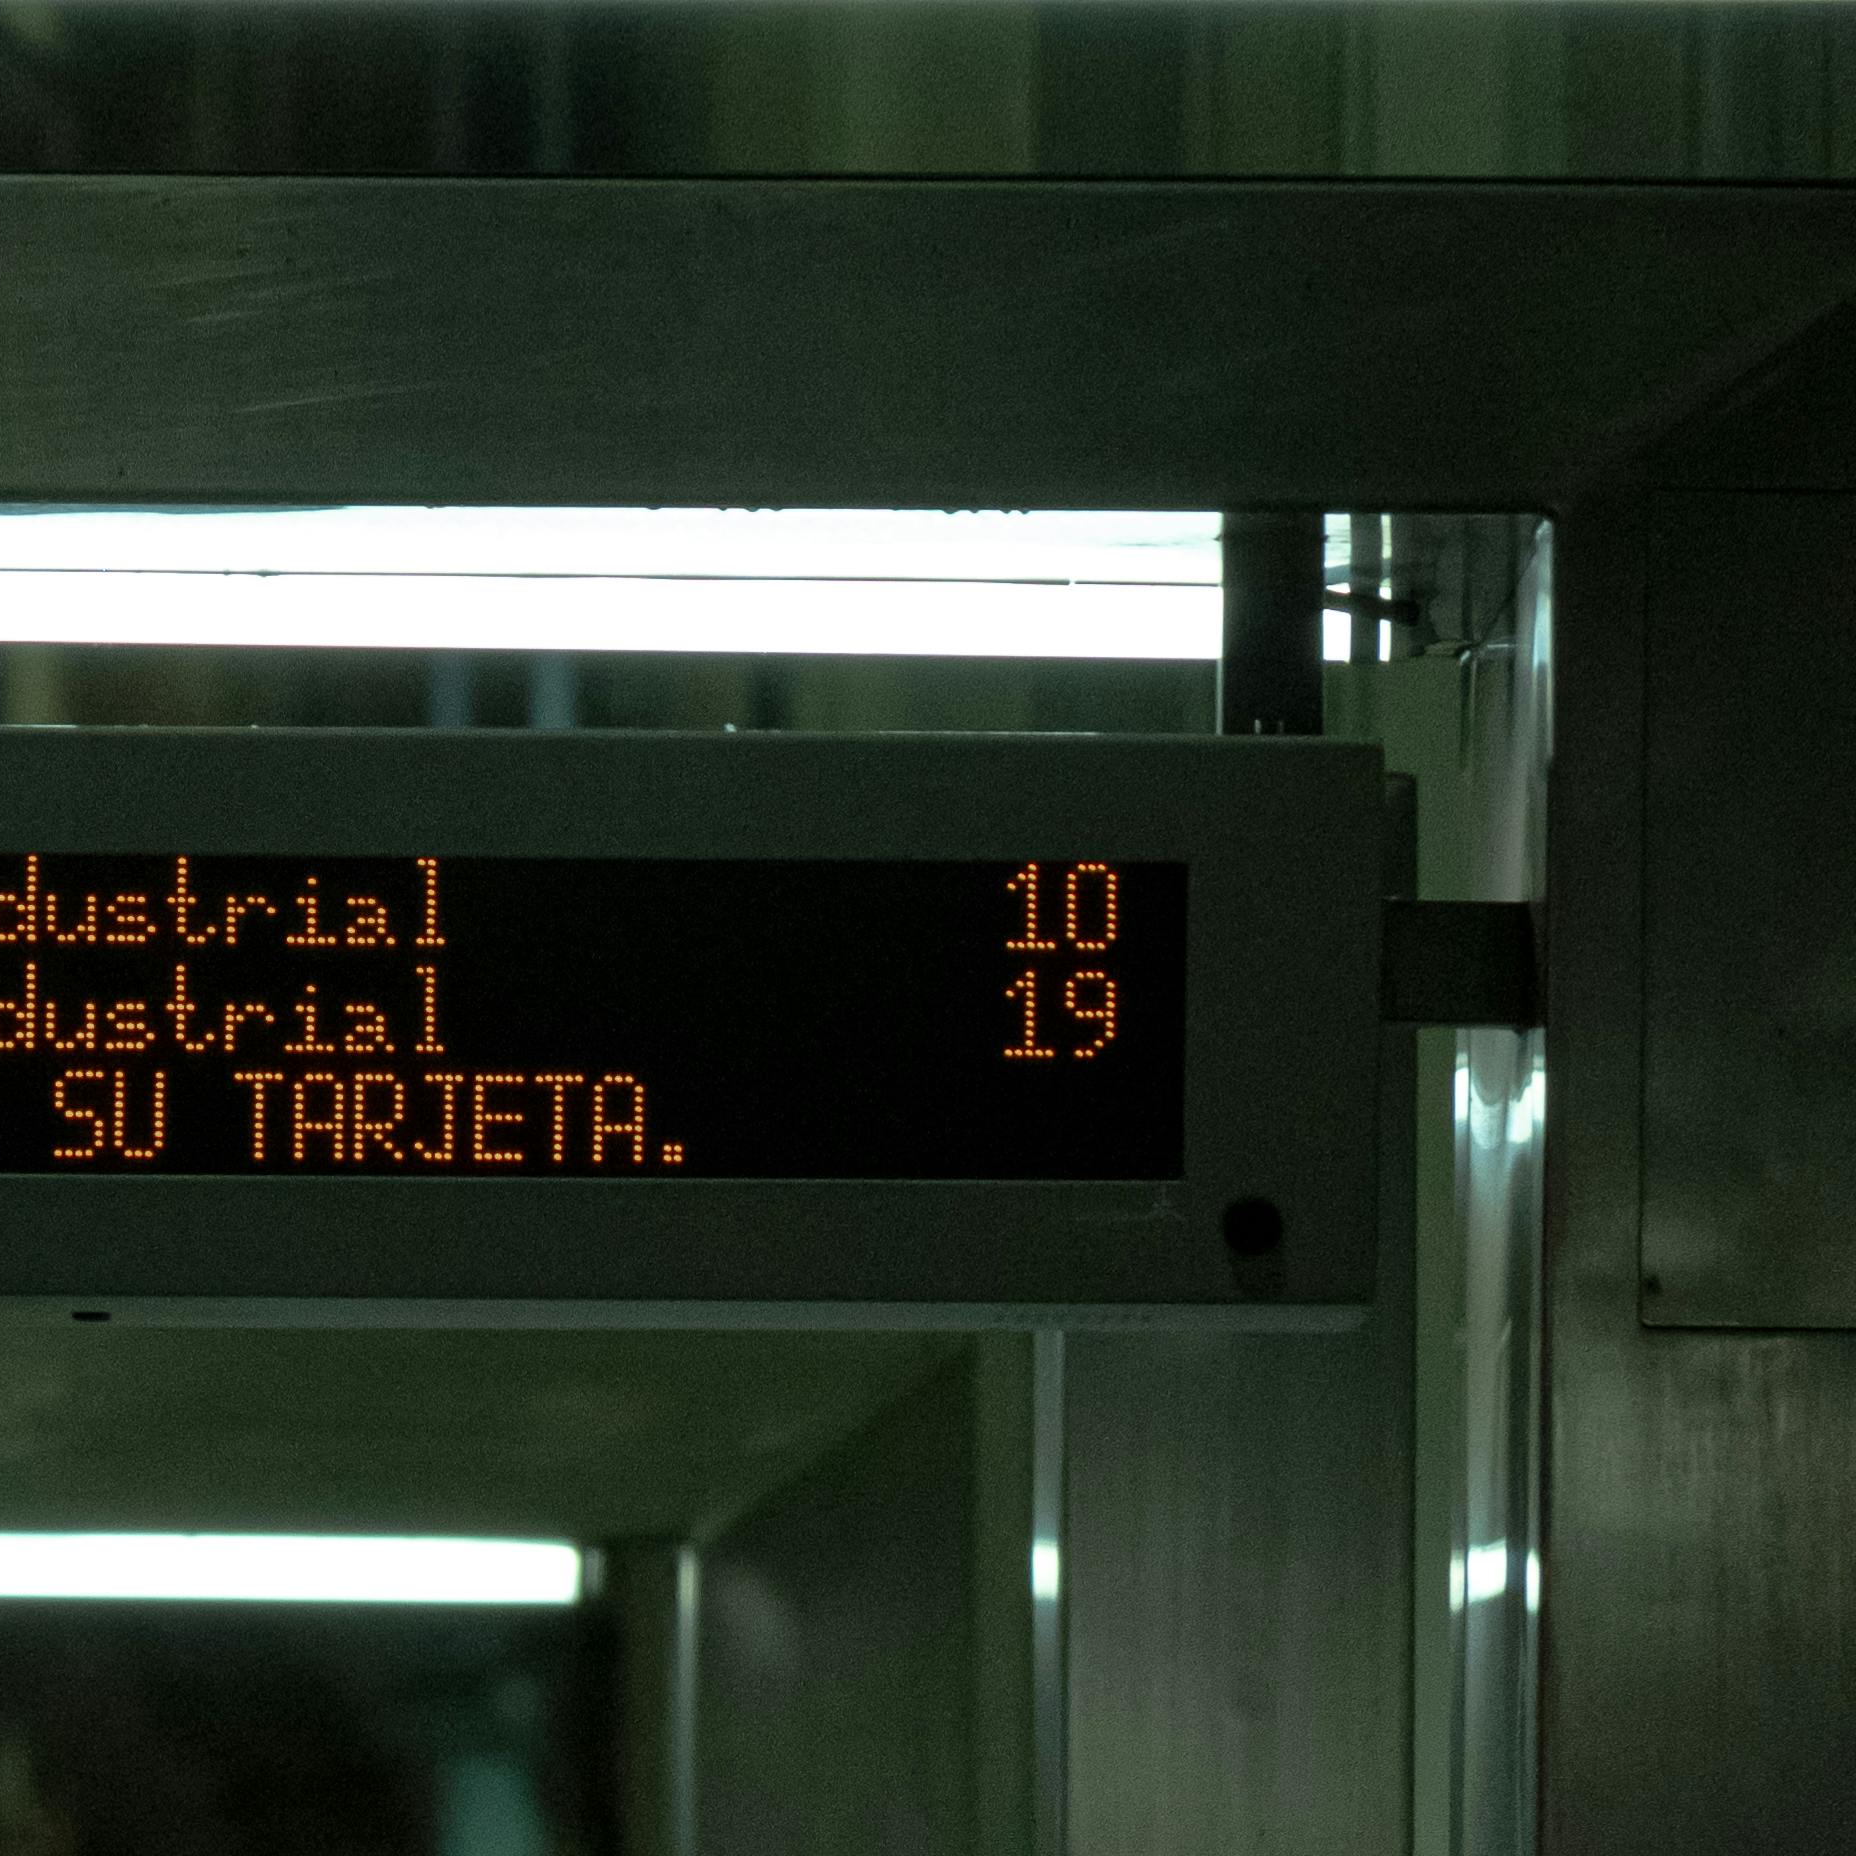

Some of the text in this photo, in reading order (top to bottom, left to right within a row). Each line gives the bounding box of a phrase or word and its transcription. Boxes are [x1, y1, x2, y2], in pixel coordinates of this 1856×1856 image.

[1006, 862, 1118, 951] 10
[1003, 970, 1117, 1059] 19
[53, 1069, 166, 1159] SU
[233, 1071, 684, 1164] TARJETA.
